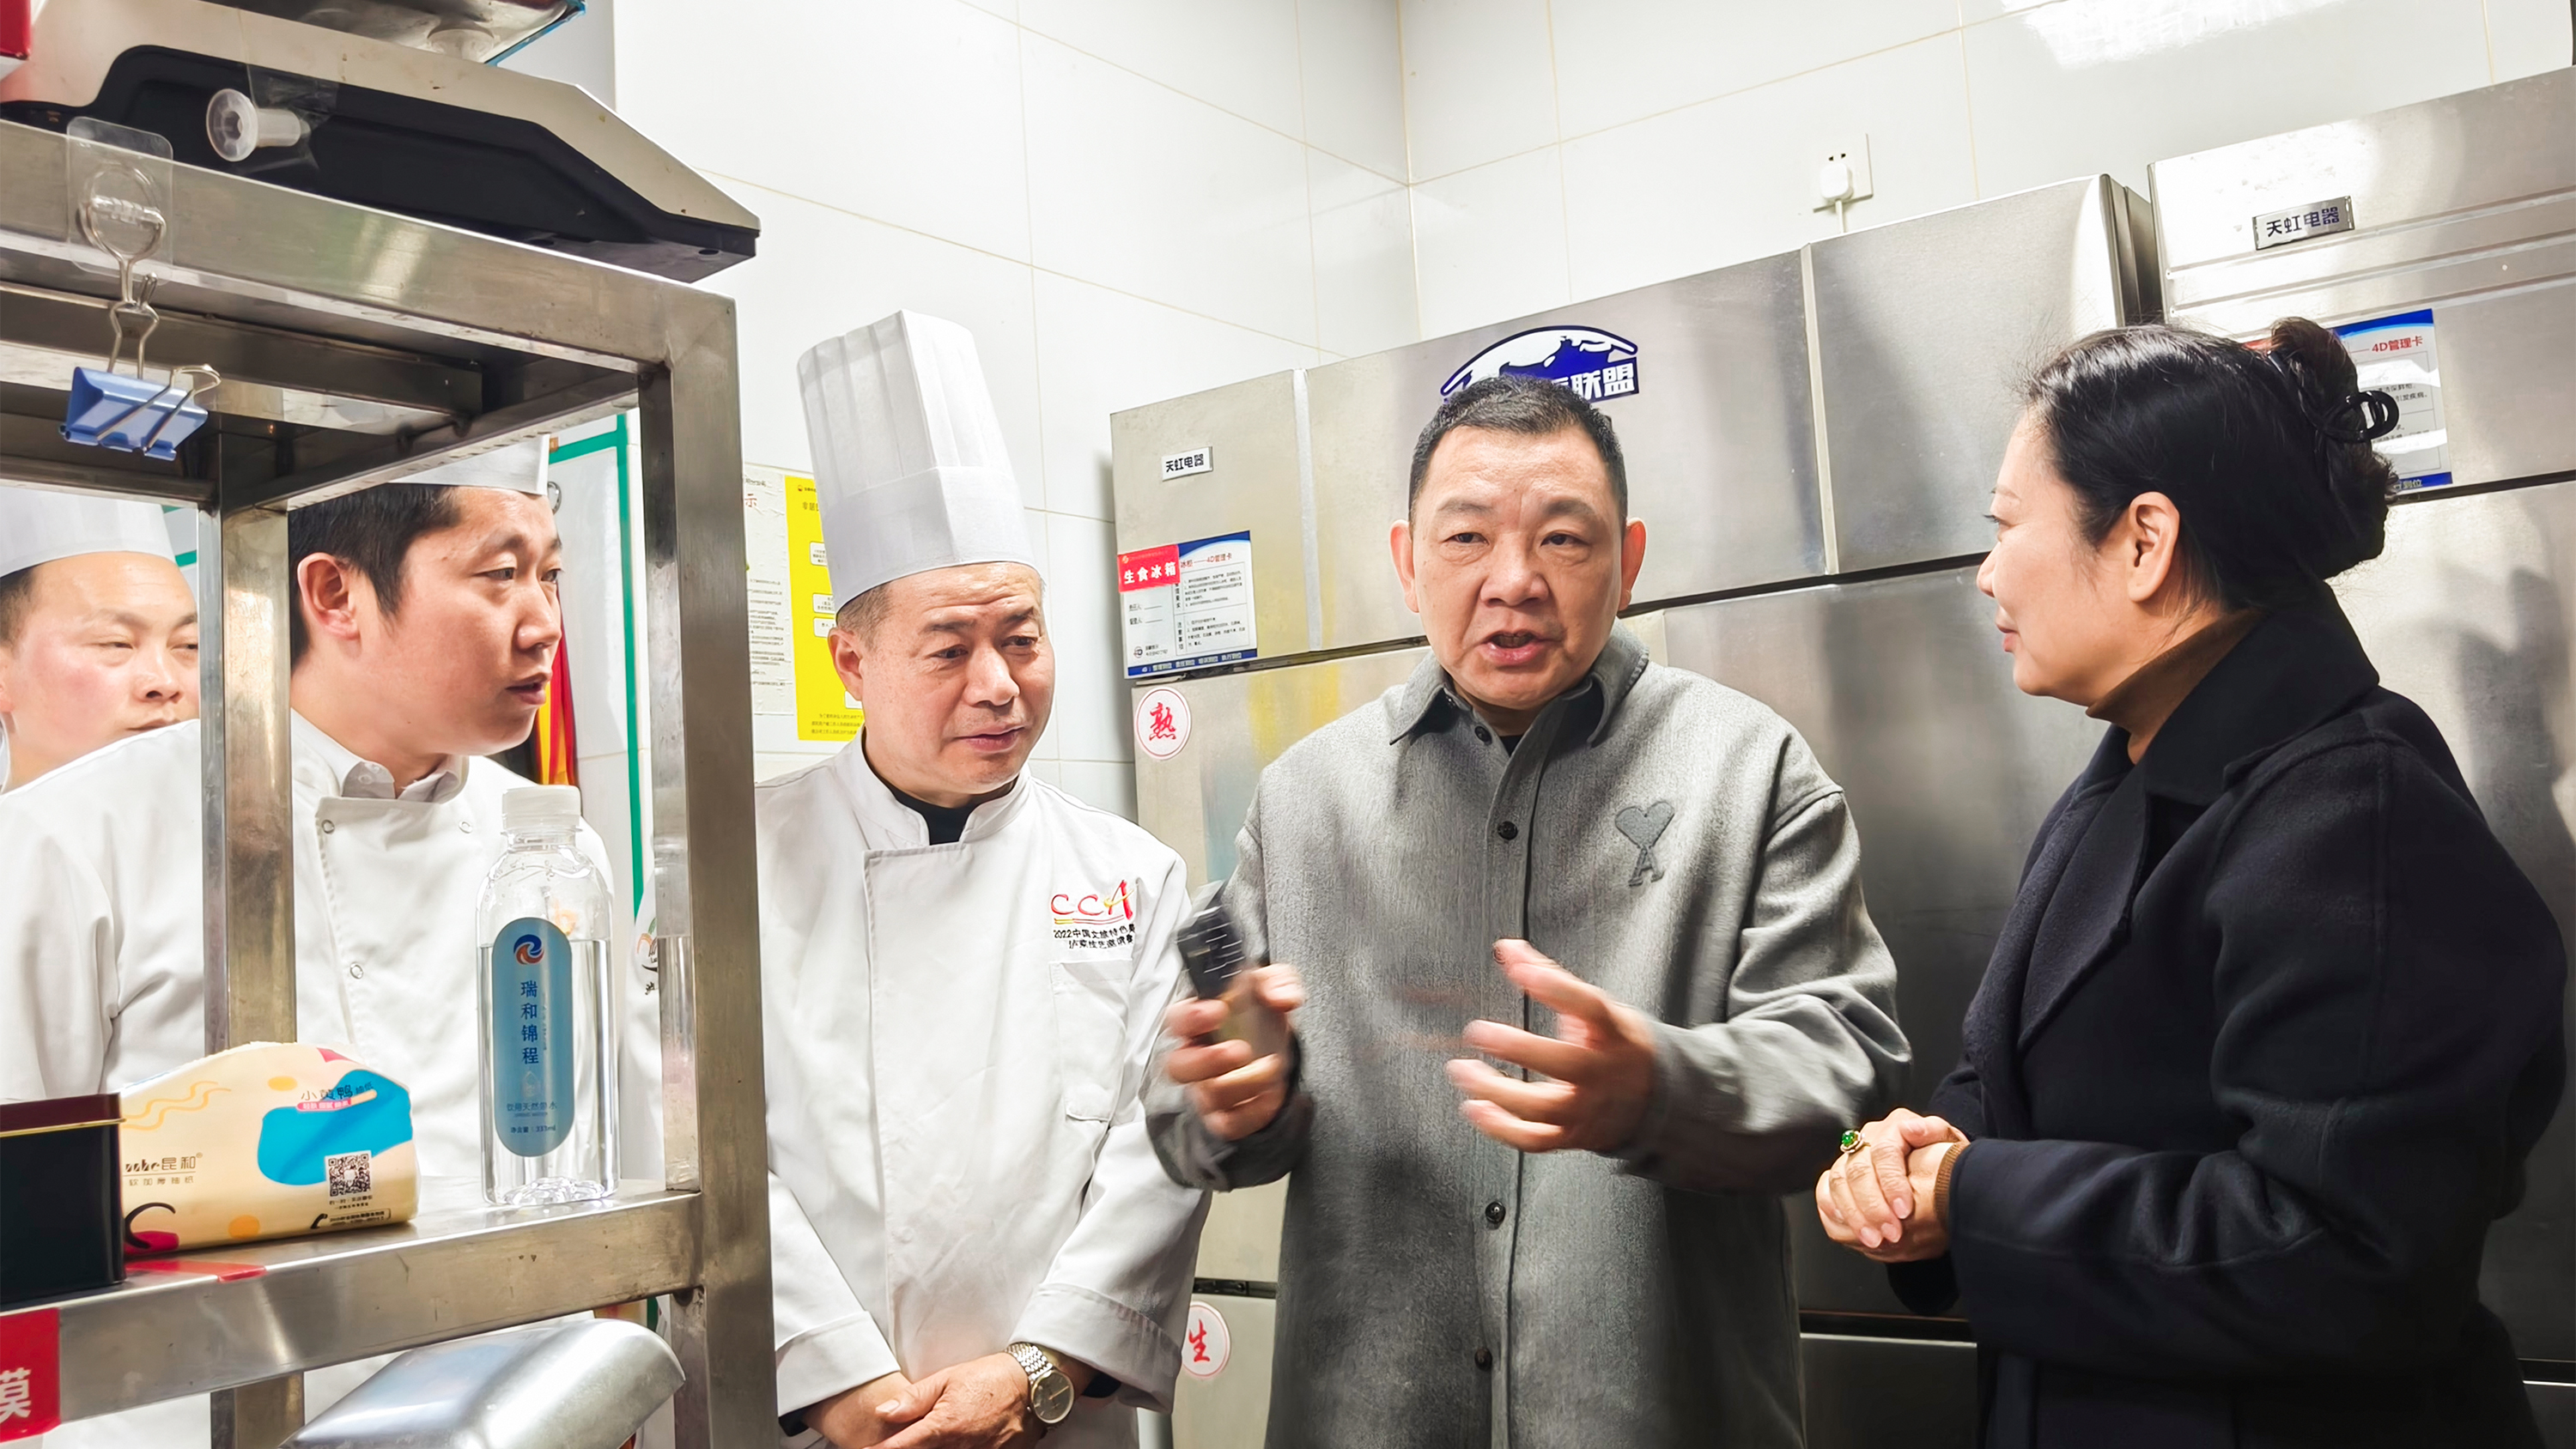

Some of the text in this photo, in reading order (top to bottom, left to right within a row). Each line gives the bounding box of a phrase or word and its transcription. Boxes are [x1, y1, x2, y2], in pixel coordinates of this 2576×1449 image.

[2267, 207, 2340, 237] 天虹电器
[1166, 453, 1204, 472] 天虹电器
[1124, 561, 1176, 584] 生食冰箱
[1149, 702, 1176, 741] 熟
[1051, 880, 1133, 920] CCA
[520, 980, 539, 1064] 瑞和锦程
[1188, 1319, 1211, 1363] 生
